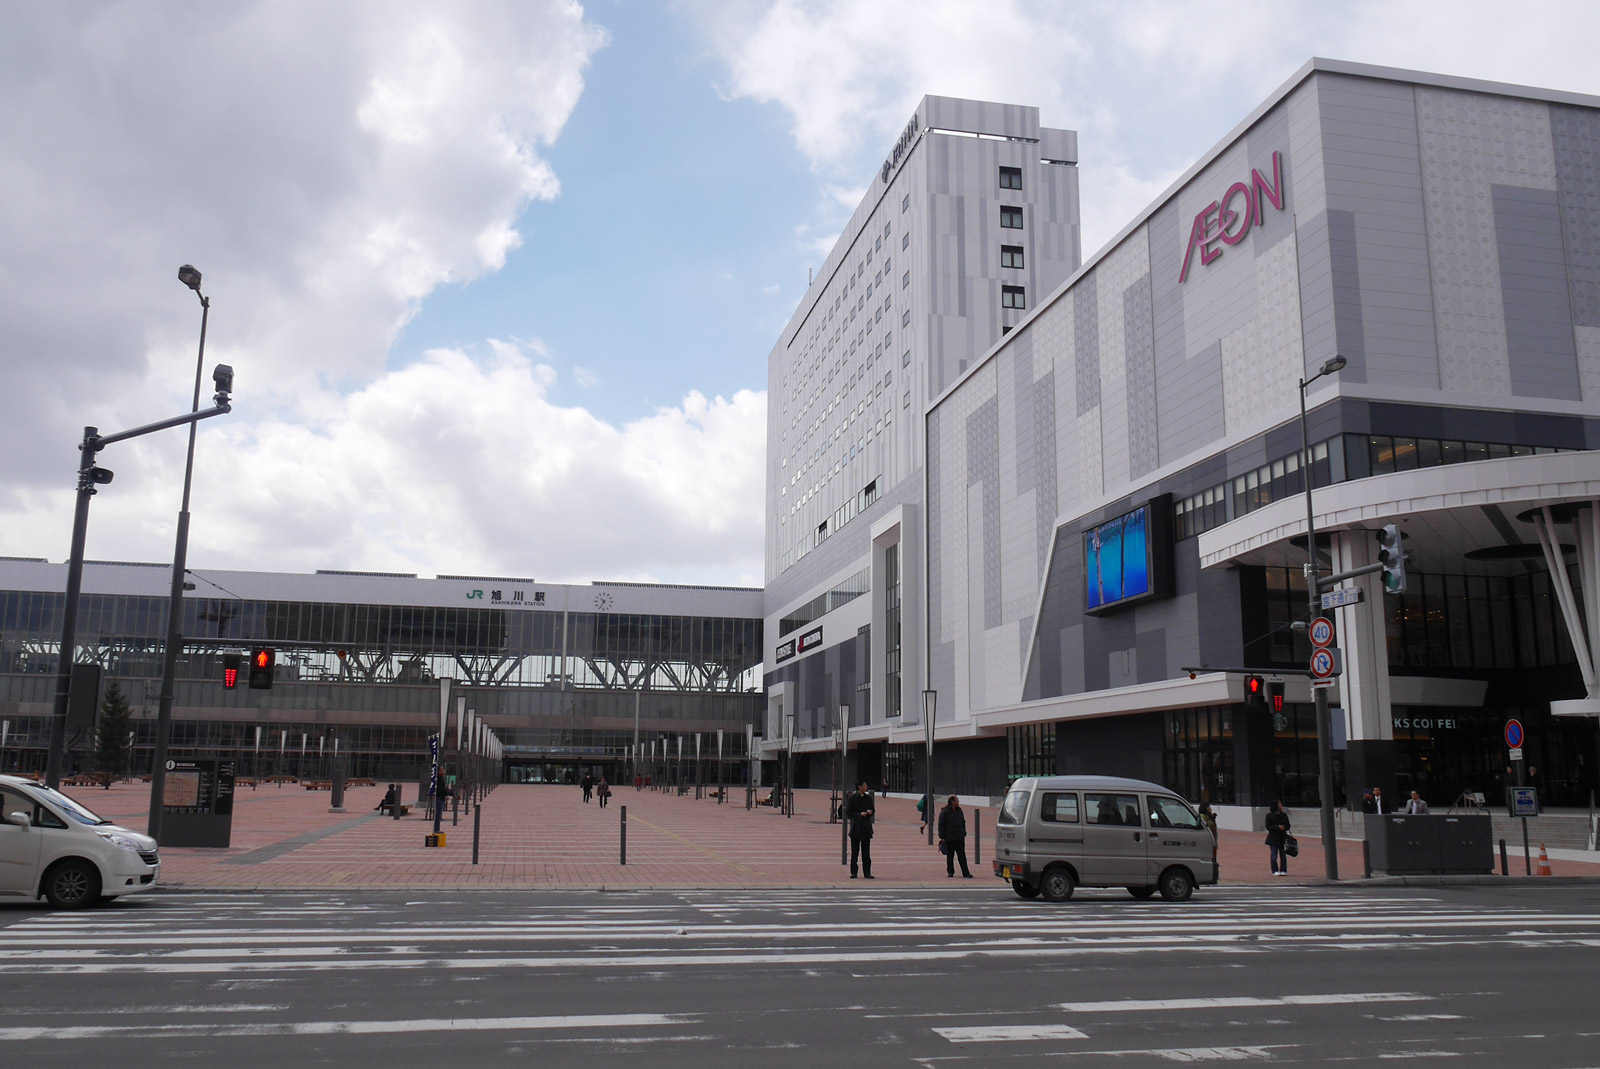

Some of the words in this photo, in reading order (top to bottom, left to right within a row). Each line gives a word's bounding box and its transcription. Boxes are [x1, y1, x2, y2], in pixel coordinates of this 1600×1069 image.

[466, 590, 483, 599] JR
[491, 590, 545, 601] 旭川駅
[1314, 625, 1329, 639] 40
